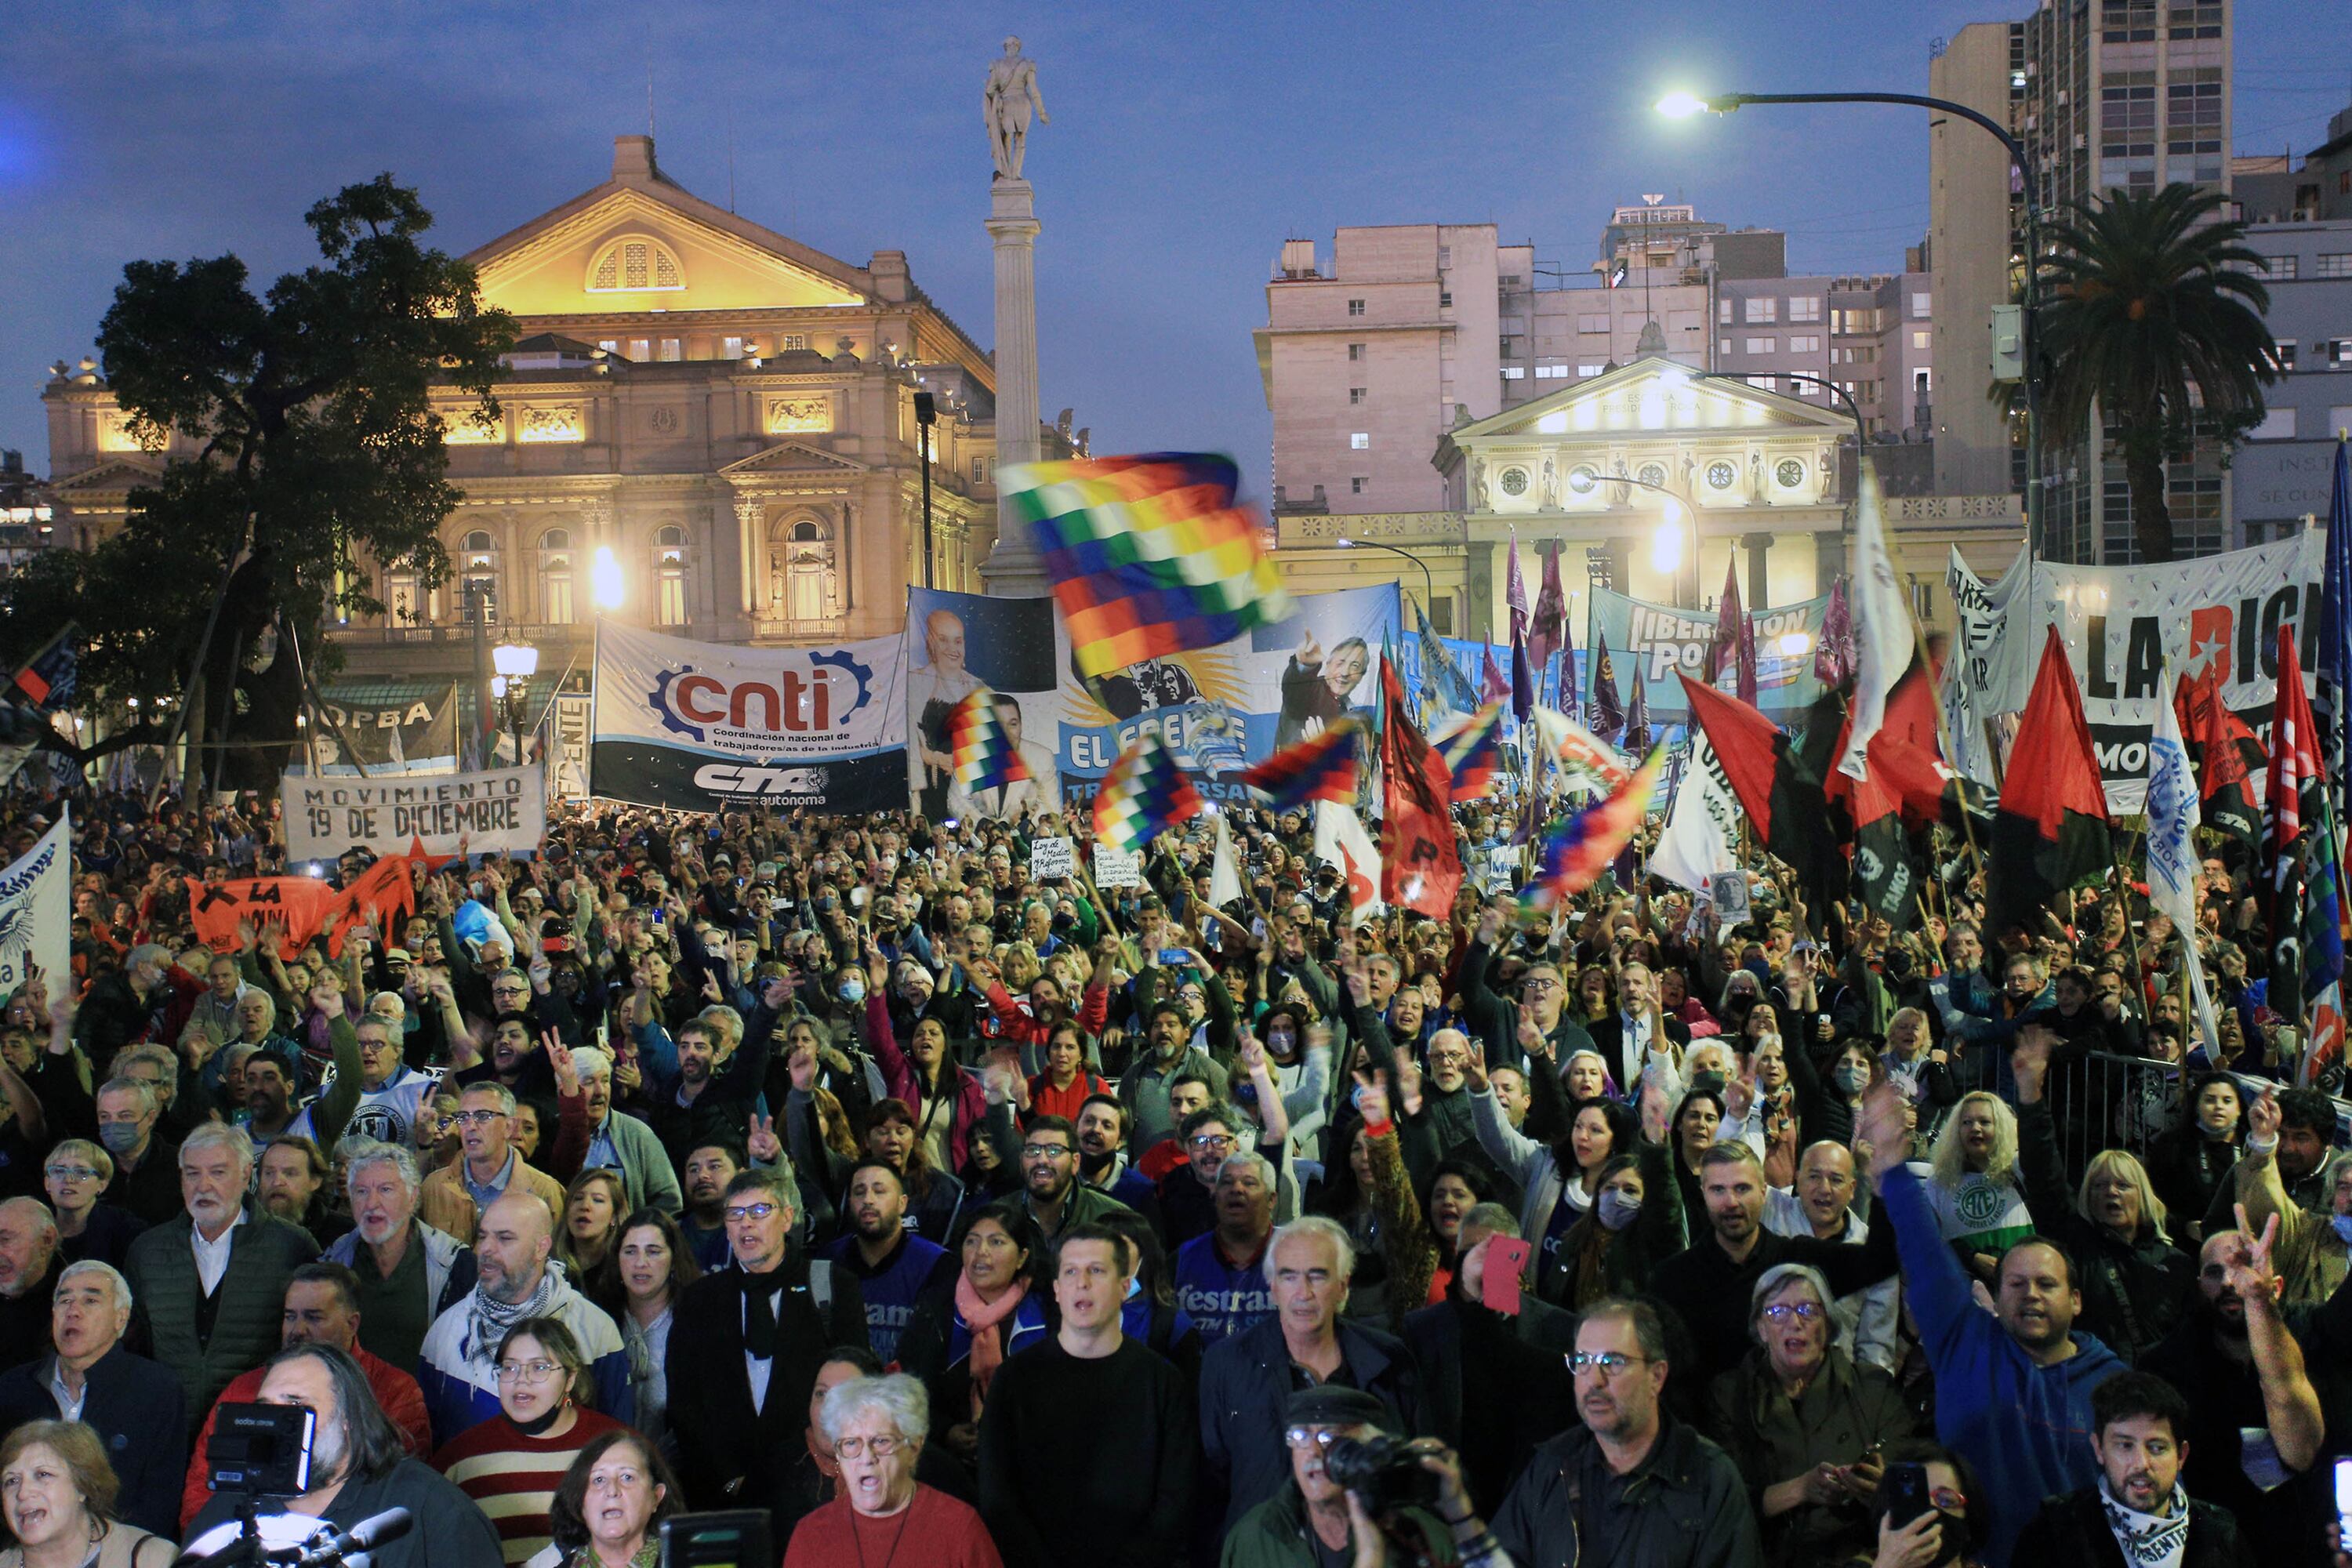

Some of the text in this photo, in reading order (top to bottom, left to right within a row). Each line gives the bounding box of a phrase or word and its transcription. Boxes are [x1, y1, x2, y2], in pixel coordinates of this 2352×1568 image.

[2087, 615, 2161, 699] LA
[676, 669, 829, 731] cnti
[787, 734, 833, 743] nacional
[837, 731, 850, 741] de
[1069, 734, 1111, 769] EL
[304, 777, 521, 805] MOVIMIENTO
[307, 797, 521, 839] 19 DE DICIEMBRE
